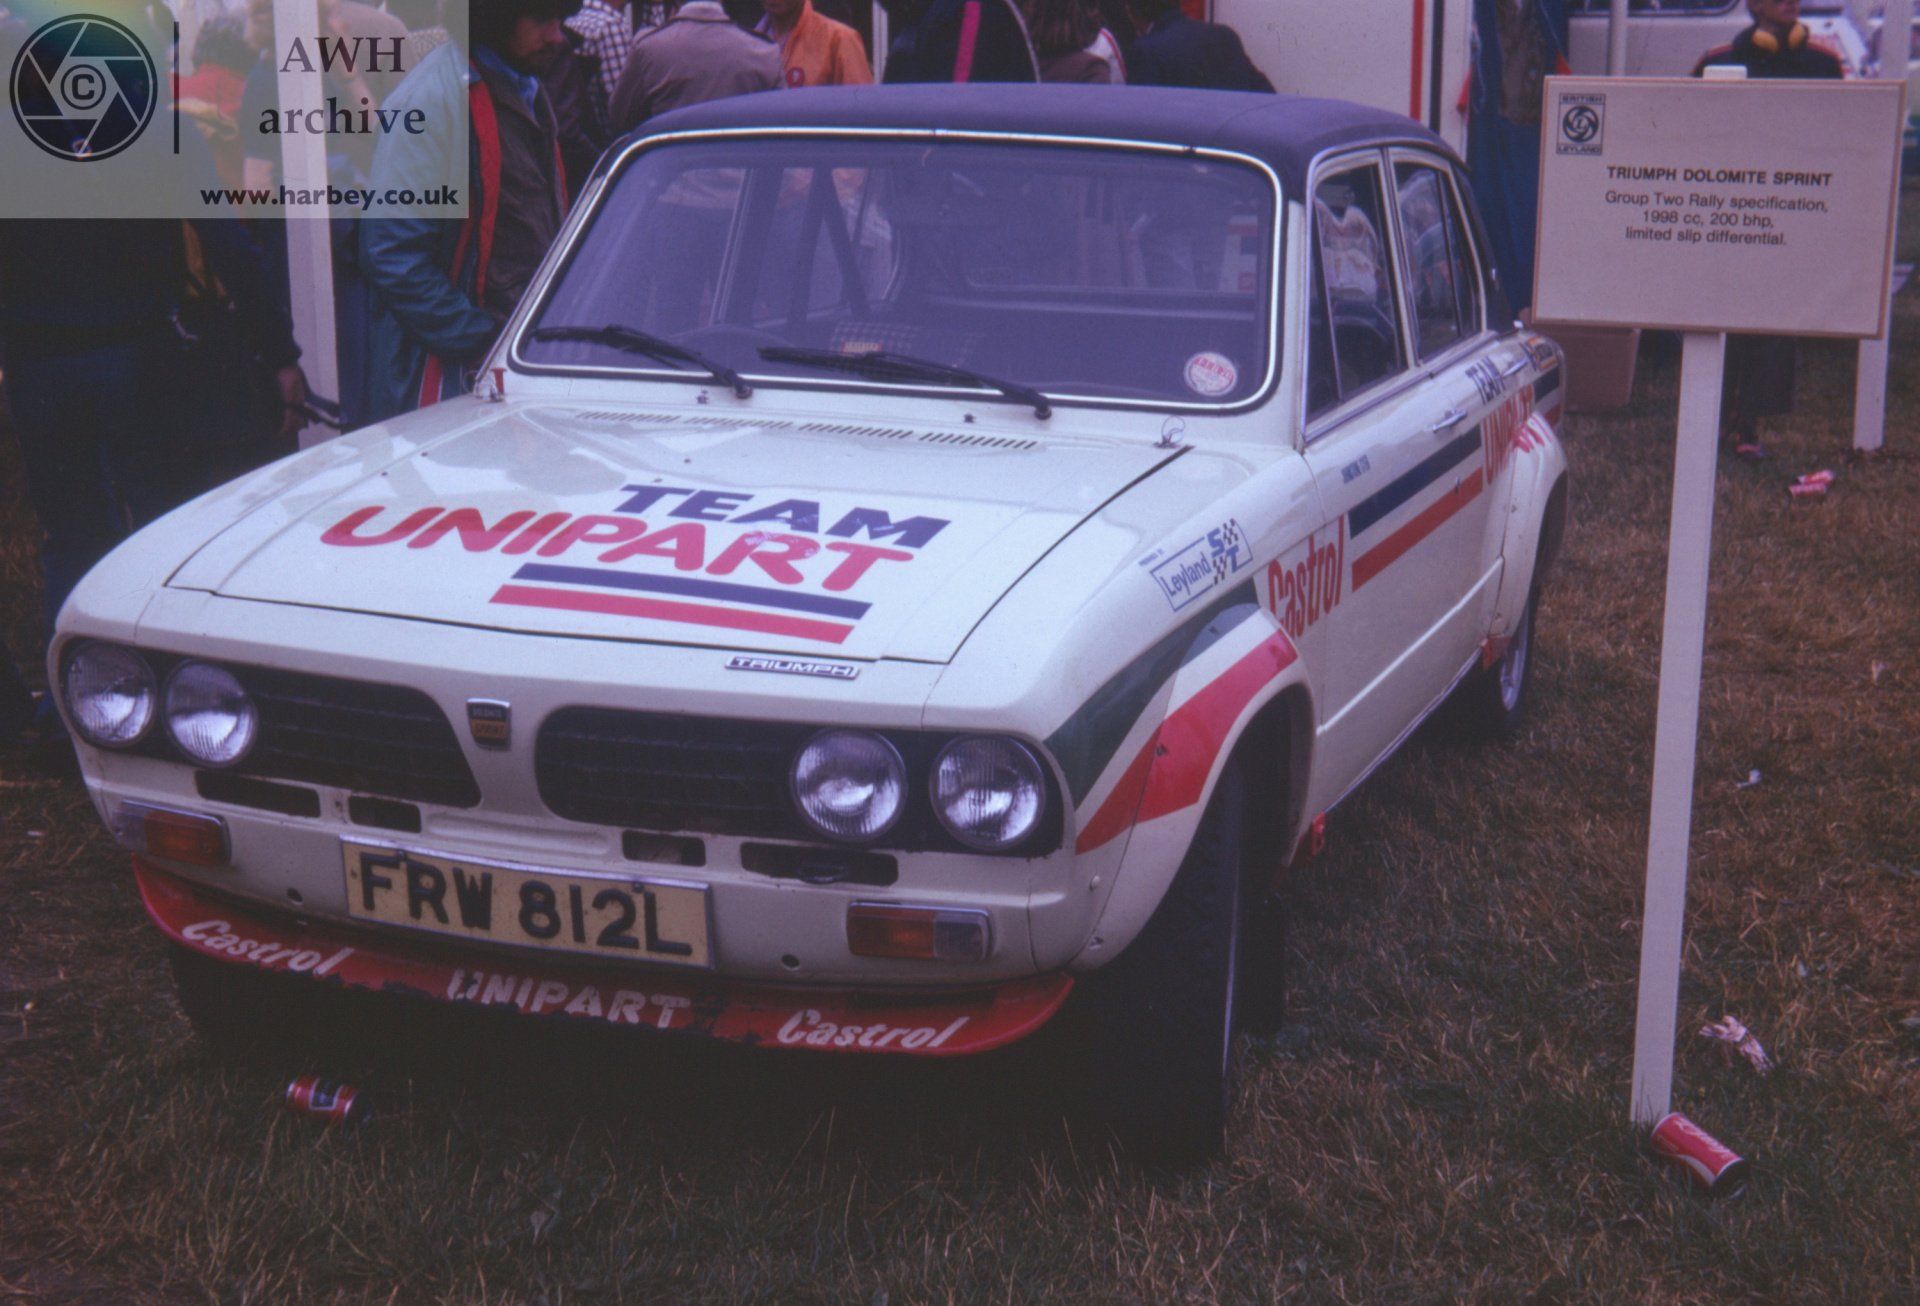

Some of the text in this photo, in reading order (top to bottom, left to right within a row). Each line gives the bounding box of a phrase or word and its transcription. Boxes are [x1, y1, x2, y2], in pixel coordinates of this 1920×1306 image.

[1558, 145, 1601, 154] LEYLAND
[1607, 166, 1832, 187] TRIUMPH DOLOMITE SPRINT
[1605, 190, 1829, 213] Group Two Rally specification,
[1643, 211, 1774, 230] 1998 cc, 200 bhp,
[1626, 226, 1787, 246] limited slip differential.
[613, 483, 952, 549] TEAM
[320, 505, 915, 592] UNIPART
[1160, 551, 1212, 597] Leyland
[1267, 514, 1345, 641] Castrol
[735, 656, 853, 676] TRIUMPH
[360, 852, 693, 956] FRW 812L
[182, 918, 354, 975] Castrol
[447, 967, 692, 1029] UNIPART
[776, 1008, 971, 1049] Castrol
